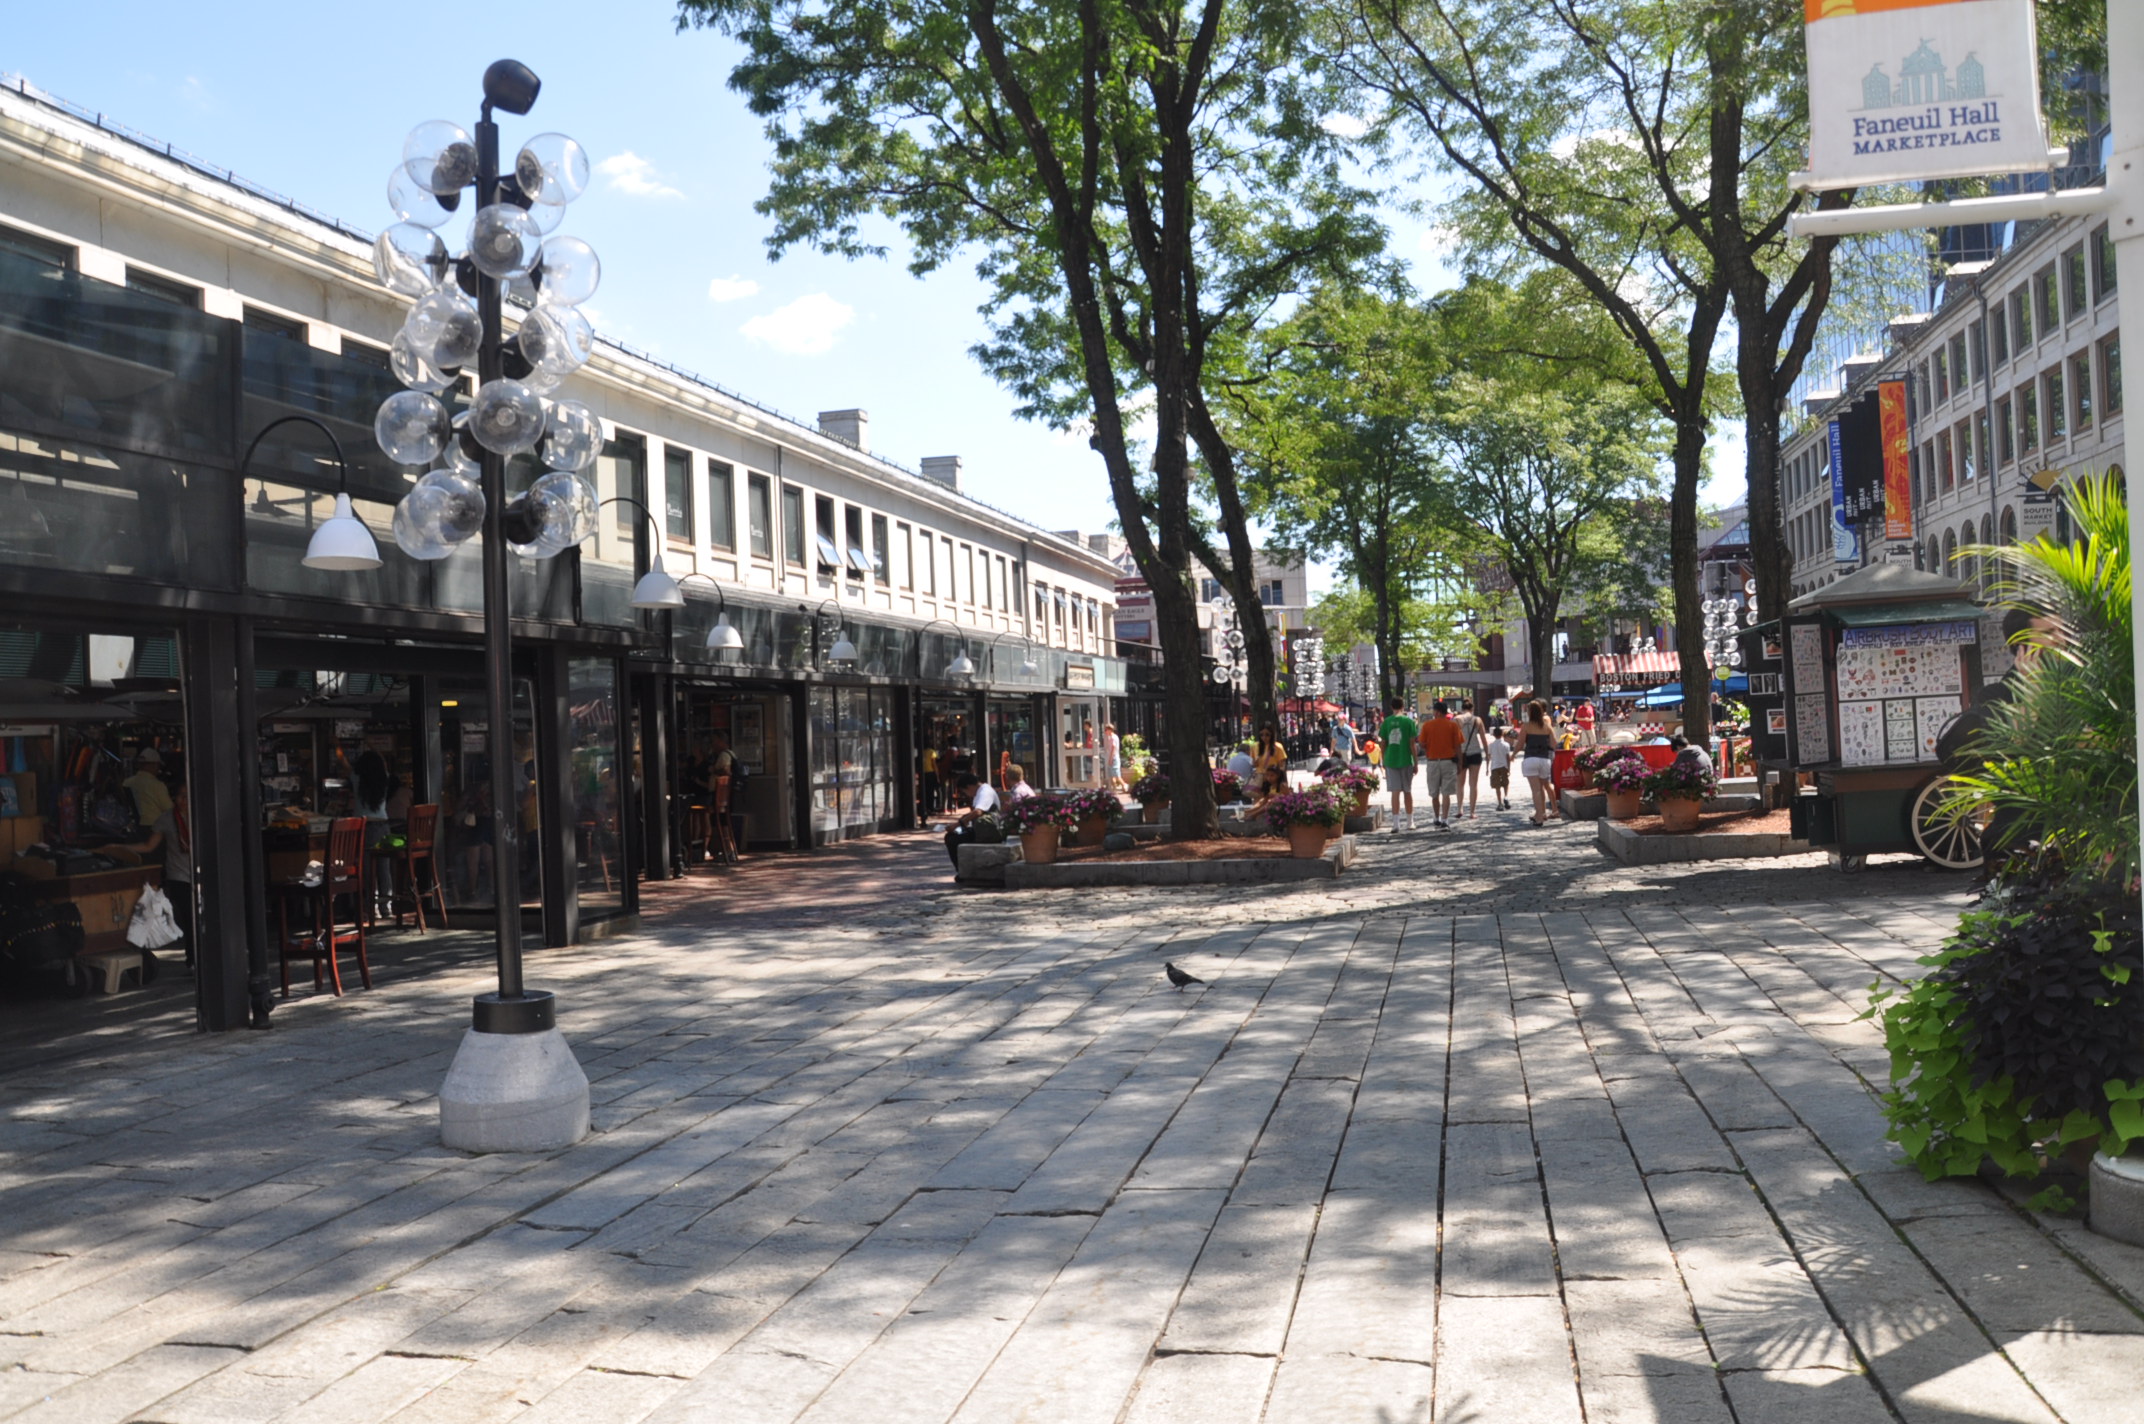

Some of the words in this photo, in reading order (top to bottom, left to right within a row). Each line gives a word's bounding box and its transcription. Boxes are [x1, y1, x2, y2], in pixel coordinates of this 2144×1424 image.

[1853, 108, 1942, 137] Faneuil
[1948, 101, 2001, 126] Hall
[1853, 128, 2002, 156] MARKETPLACE
[1831, 425, 1840, 446] Hall
[1833, 449, 1843, 487] Faneuil
[1845, 628, 1907, 644] AIRBRUSH
[1911, 626, 1945, 640] BODY
[1948, 623, 1974, 638] ART
[1599, 672, 1639, 682] BOSTON
[1644, 671, 1671, 680] FRIED
